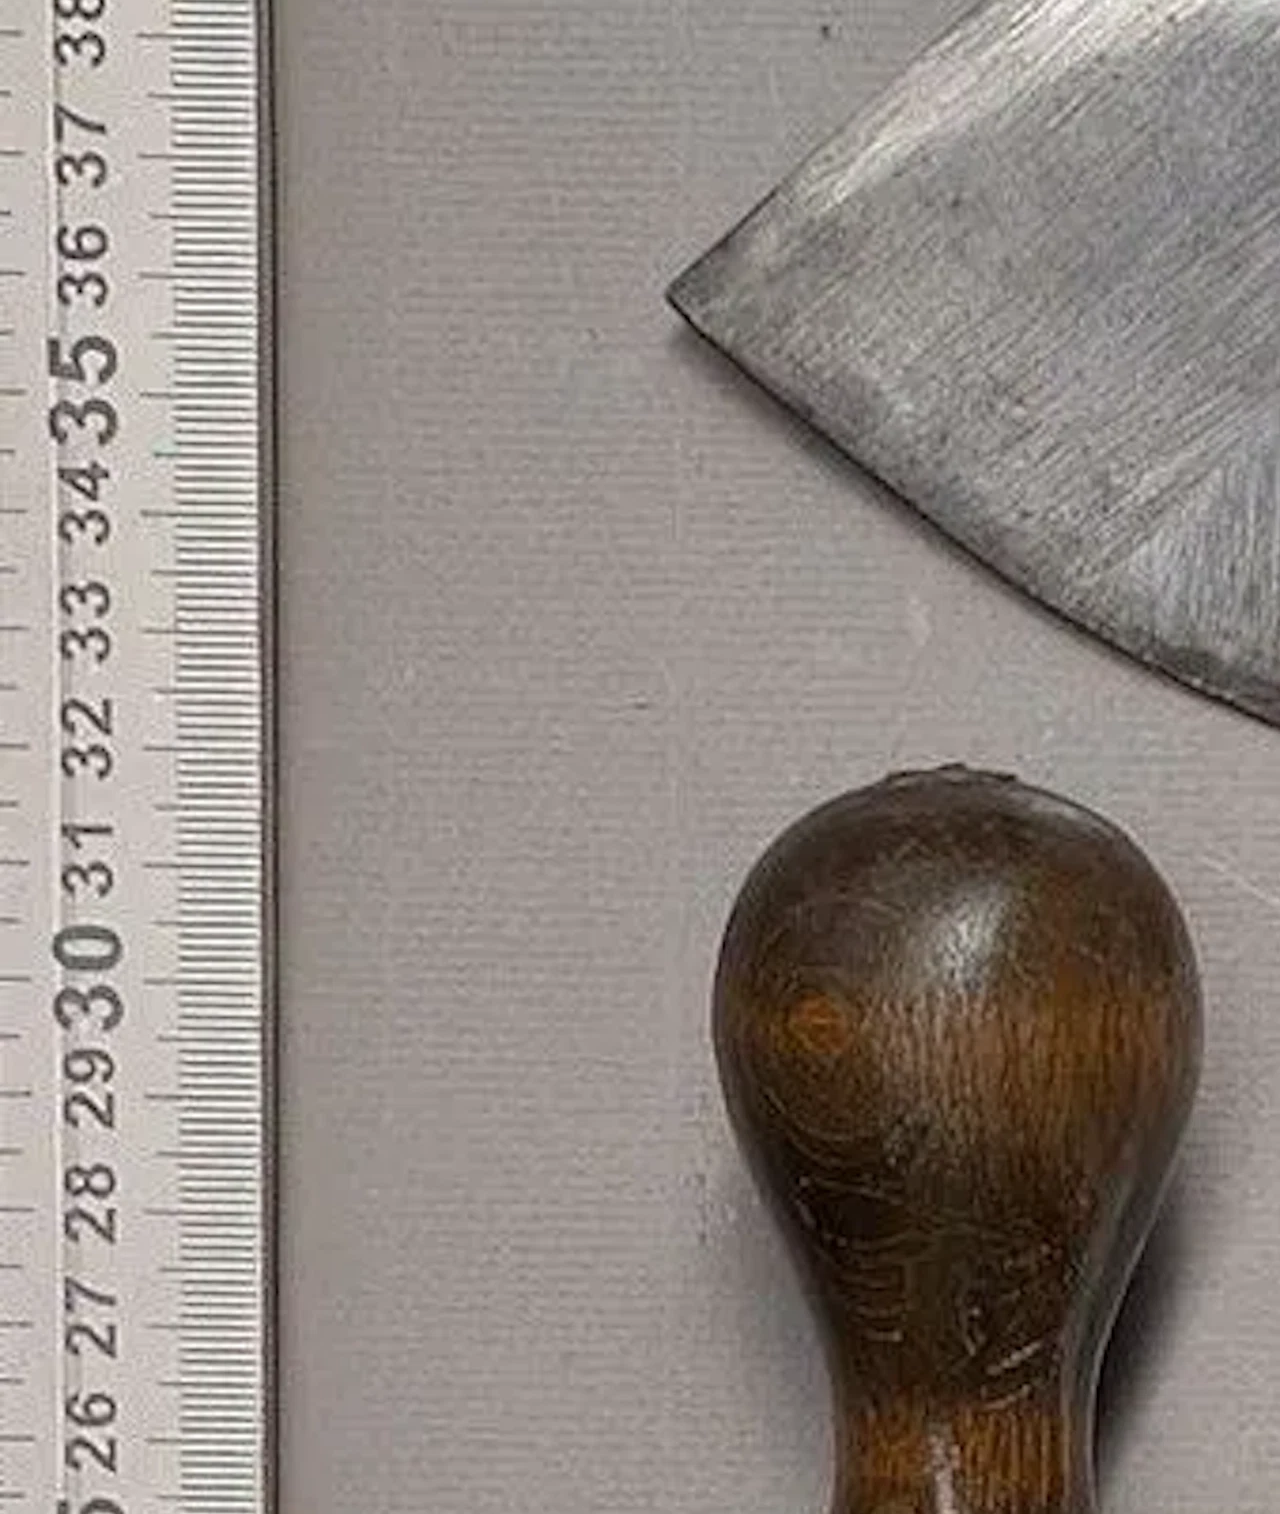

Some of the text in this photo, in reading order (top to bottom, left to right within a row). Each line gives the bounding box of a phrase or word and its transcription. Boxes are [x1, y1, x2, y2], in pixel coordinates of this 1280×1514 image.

[52, 100, 109, 190] 37
[54, 223, 110, 309] 36
[45, 334, 119, 448] 35
[56, 460, 112, 547] 34
[57, 580, 112, 666] 33
[59, 683, 114, 782] 32
[59, 821, 115, 900] 31
[51, 924, 125, 1033] 30
[61, 1047, 116, 1131] 29
[62, 1162, 117, 1246] 28
[63, 1275, 118, 1360] 27
[63, 1383, 118, 1475] 26
